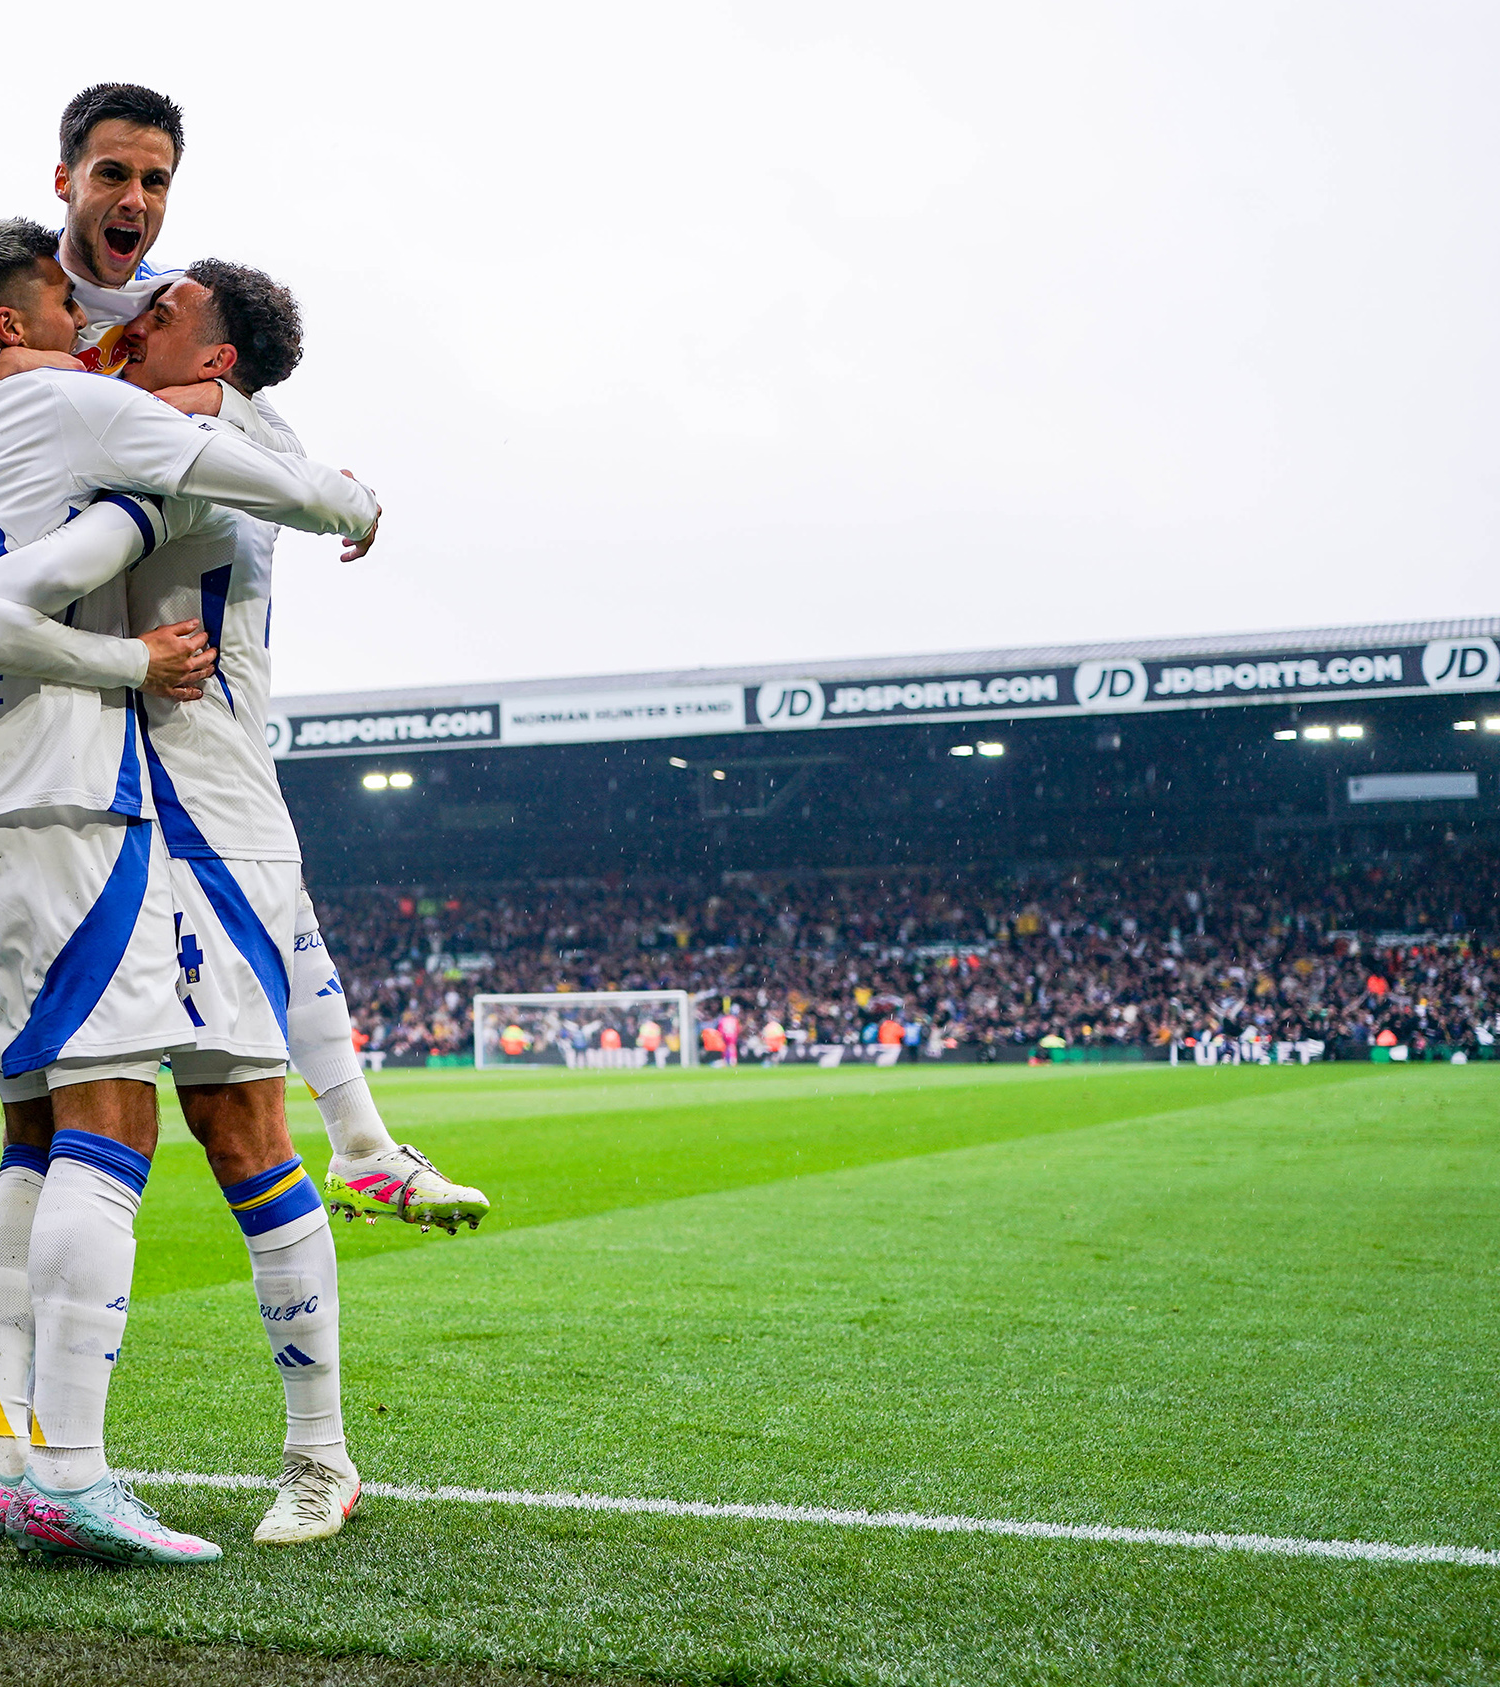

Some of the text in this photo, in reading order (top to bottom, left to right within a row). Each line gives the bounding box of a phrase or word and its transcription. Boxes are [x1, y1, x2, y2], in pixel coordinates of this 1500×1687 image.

[1088, 654, 1404, 700] JD JDSPORTS.COM
[1435, 647, 1489, 681] JD
[770, 675, 1058, 718] JD JDSPORTS.COM
[295, 710, 493, 746] JDSPORTS.COM
